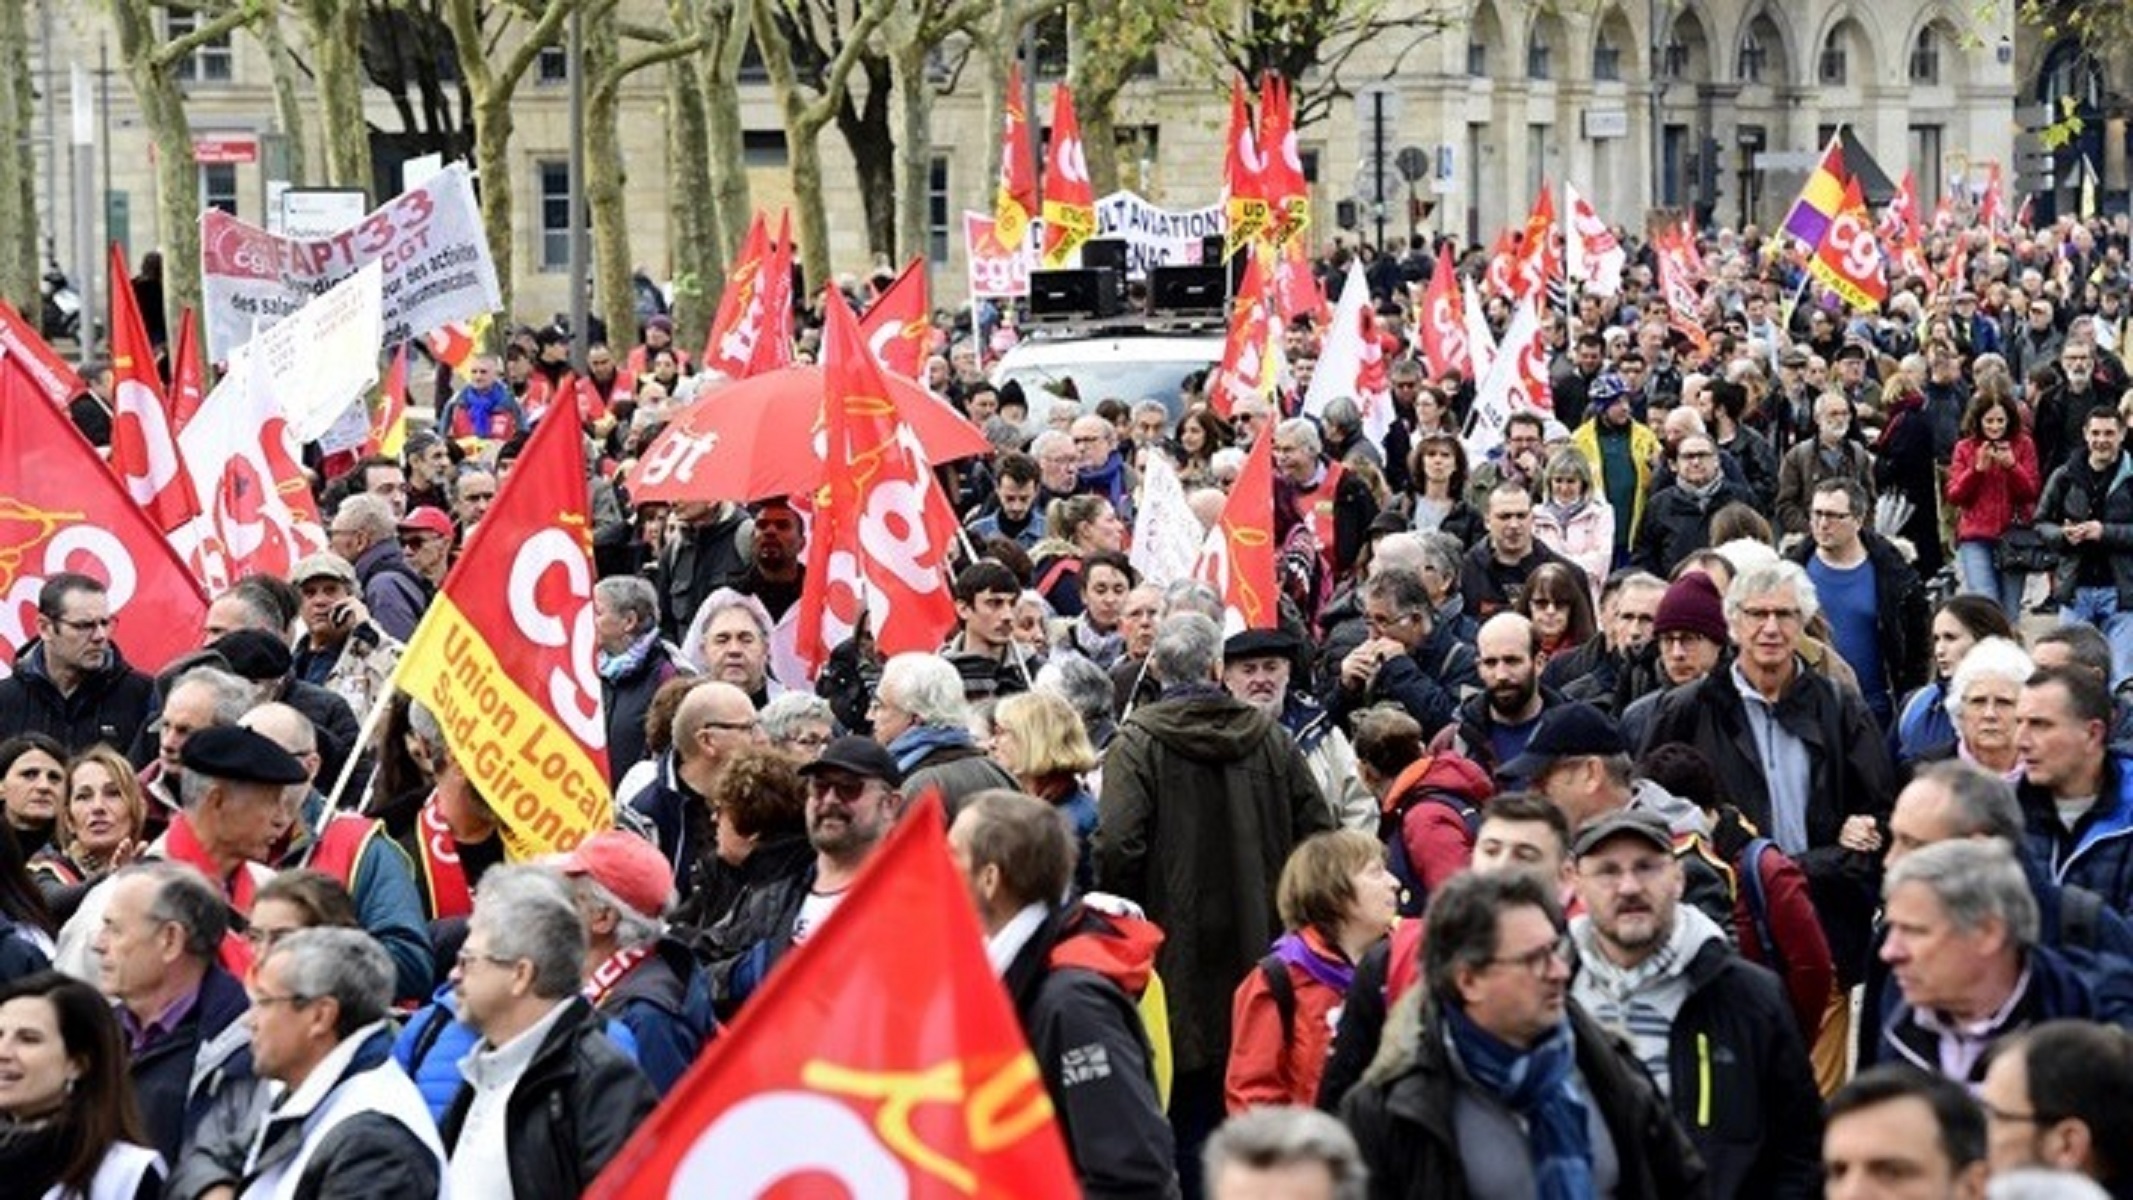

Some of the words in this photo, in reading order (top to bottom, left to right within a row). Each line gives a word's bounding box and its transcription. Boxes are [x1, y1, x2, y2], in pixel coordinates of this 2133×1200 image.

[1129, 203, 1219, 238] AVIATION
[382, 225, 430, 274] CGT
[442, 620, 519, 738] Union
